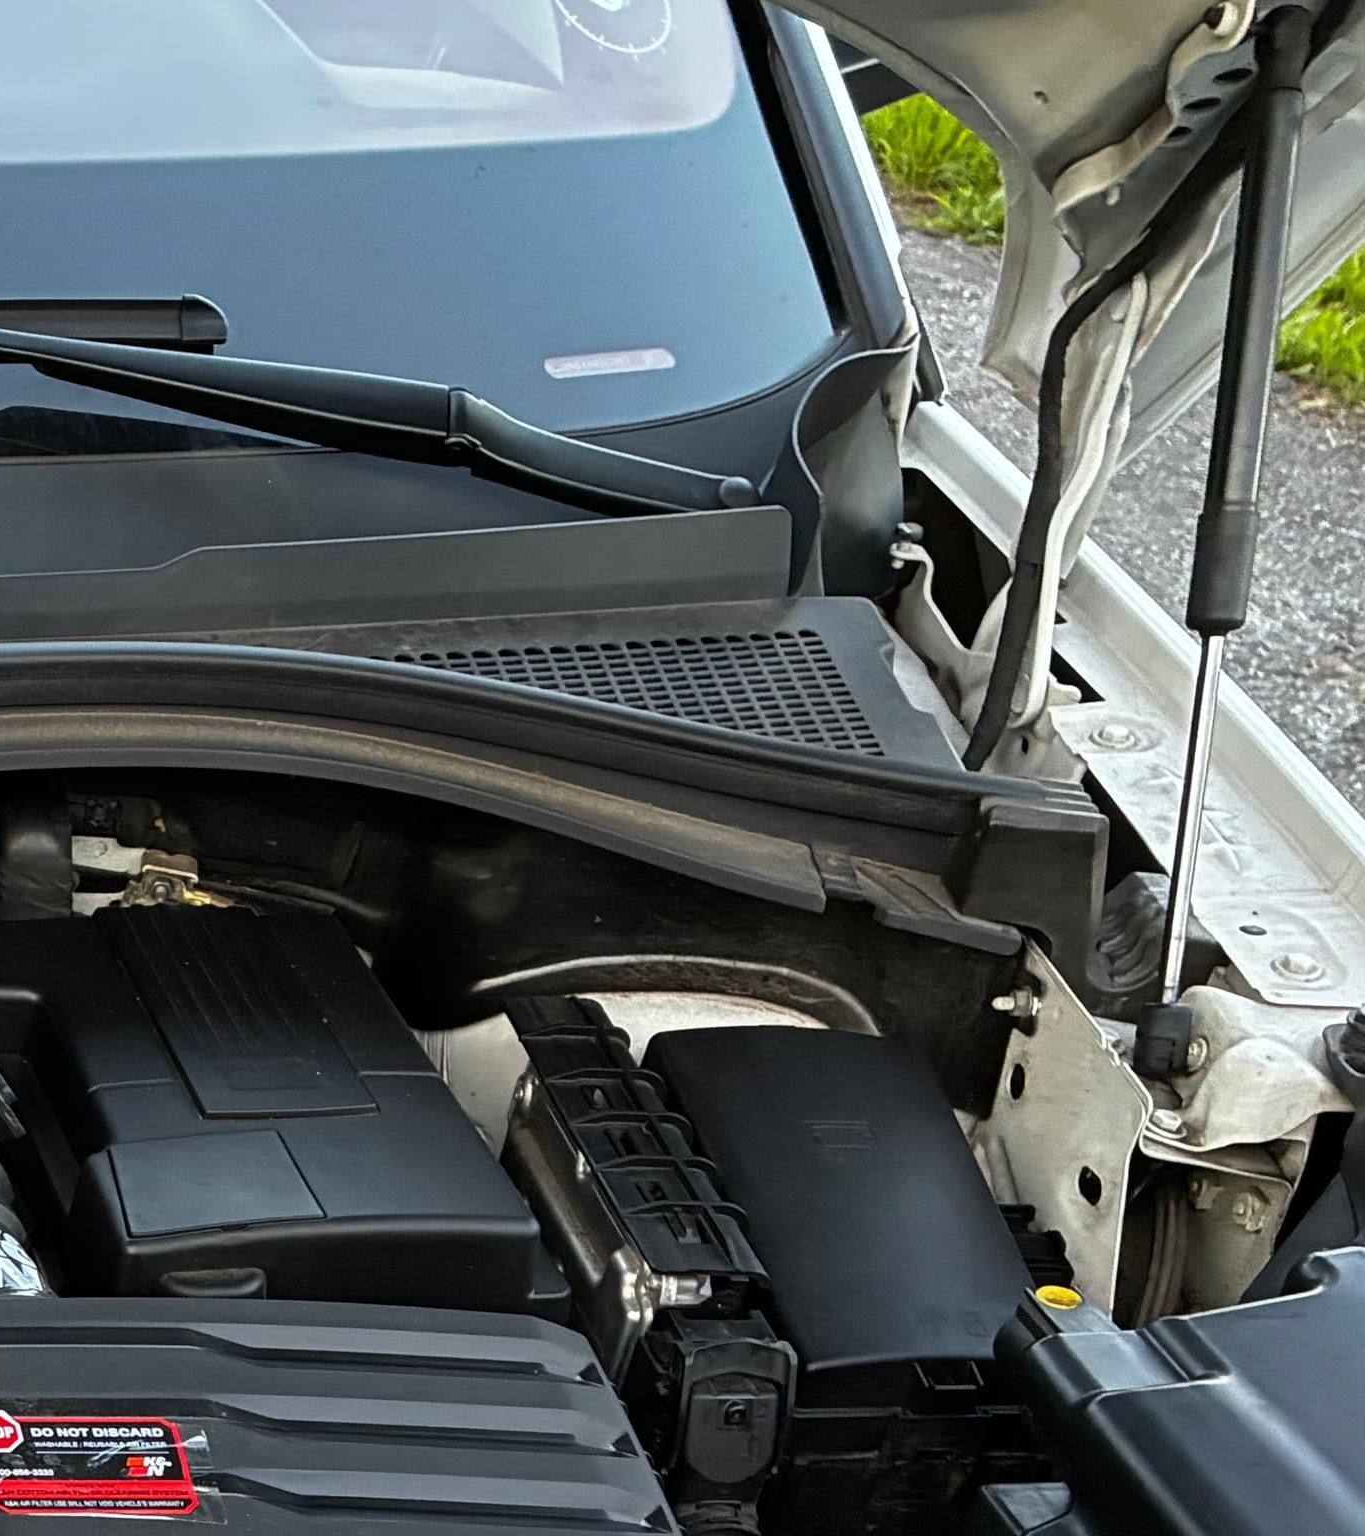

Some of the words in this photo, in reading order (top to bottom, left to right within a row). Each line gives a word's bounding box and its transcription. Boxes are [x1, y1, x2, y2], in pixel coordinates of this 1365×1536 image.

[30, 1427, 55, 1438] DO
[57, 1427, 88, 1438] NOT
[93, 1427, 164, 1438] DISCARD
